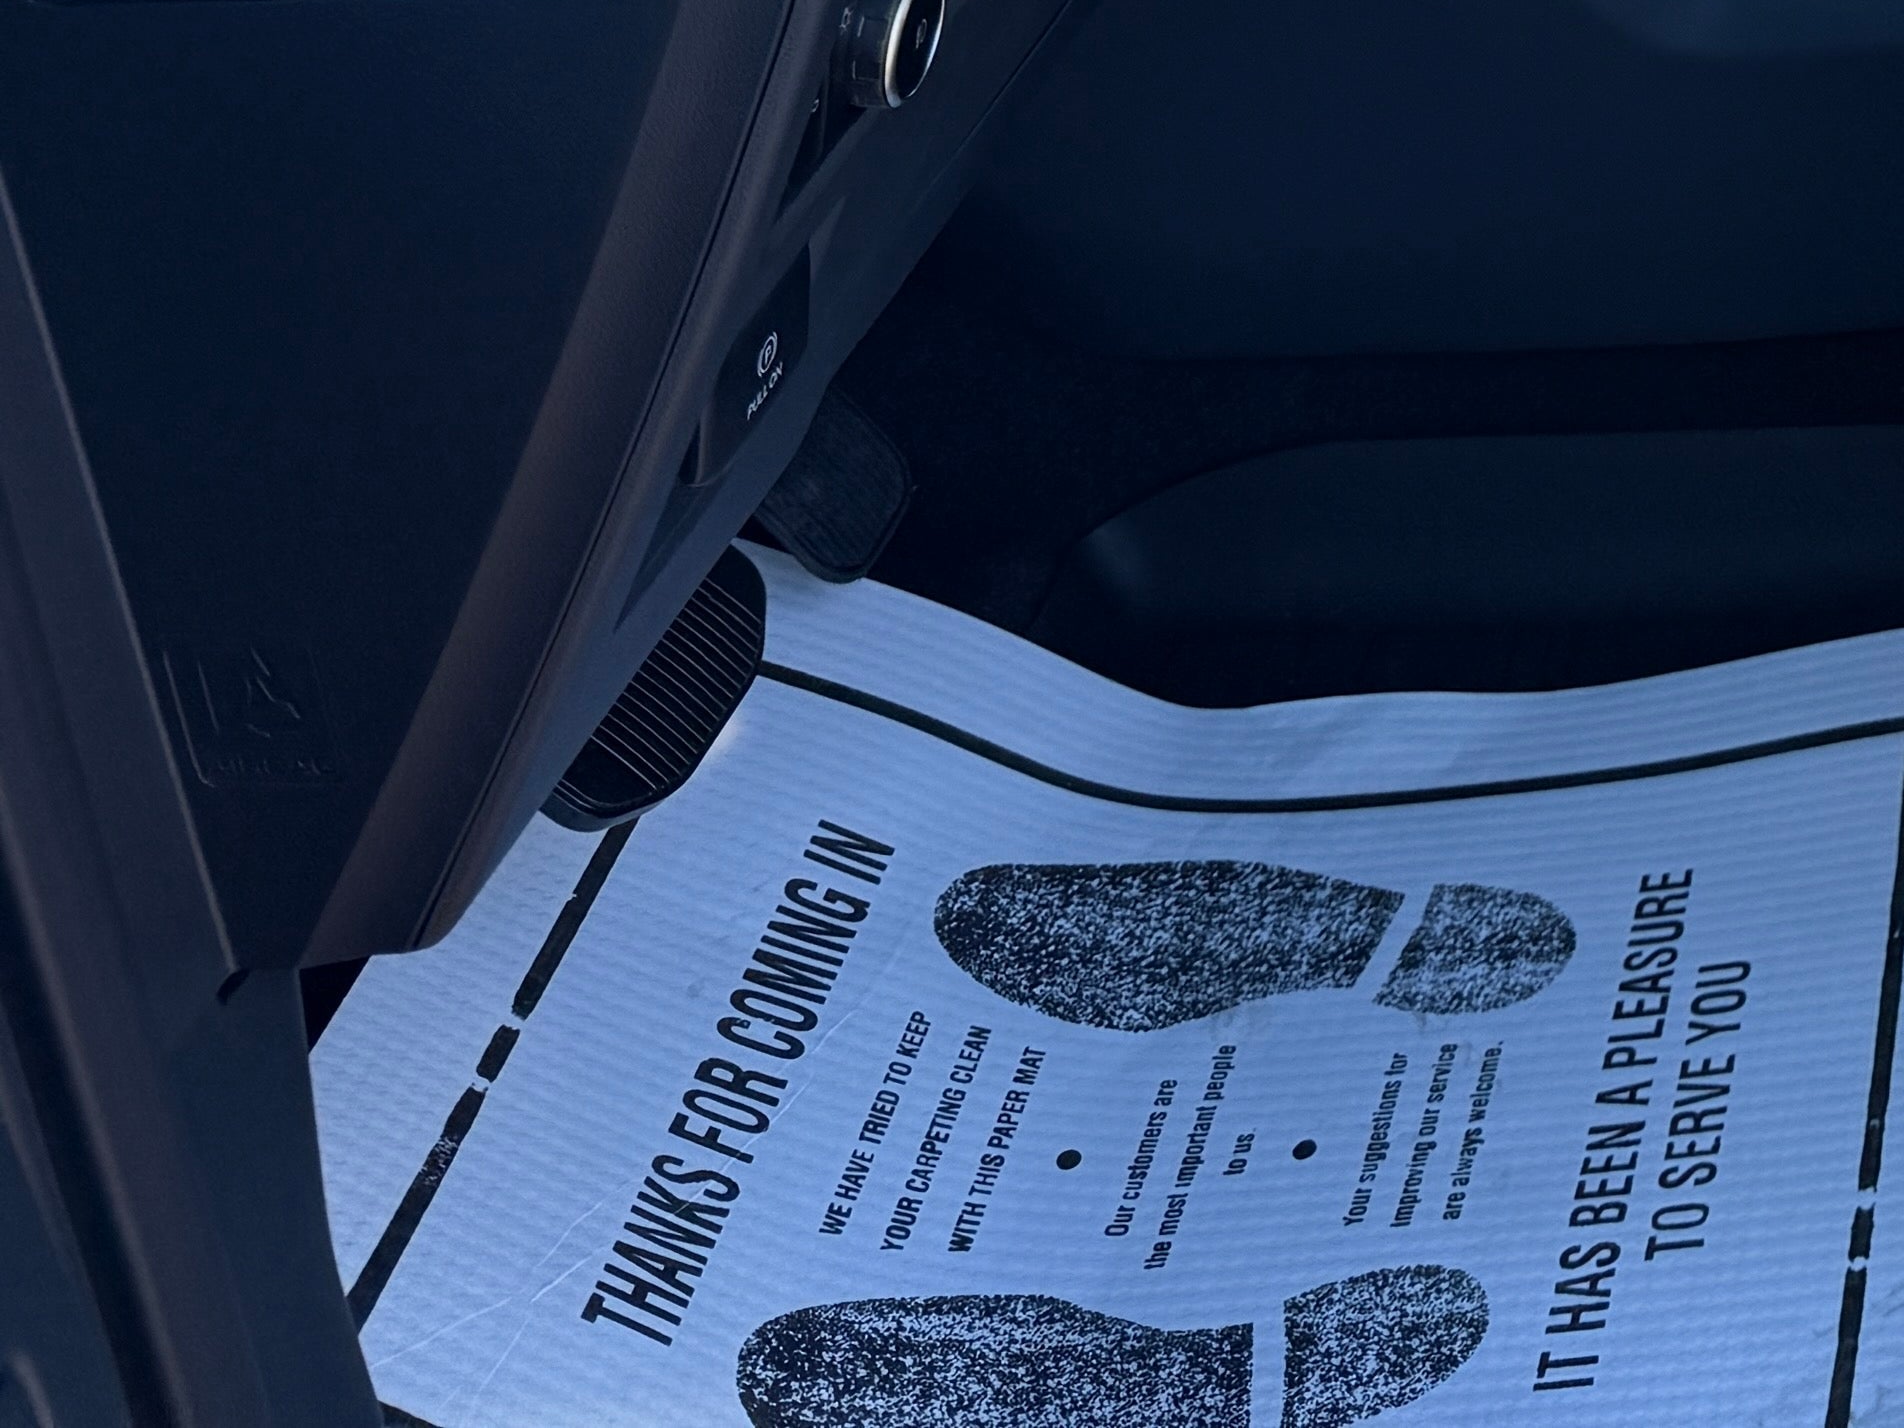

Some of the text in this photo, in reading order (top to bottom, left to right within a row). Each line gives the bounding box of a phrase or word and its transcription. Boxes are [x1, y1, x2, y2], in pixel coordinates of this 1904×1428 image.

[747, 362, 783, 420] PULL ON
[581, 819, 895, 1346] THANKS FOR COMING IN
[819, 1010, 931, 1235] WE HAVE TRIED TO KEEP
[880, 1025, 992, 1250] YOUR CARPETING CLEAN
[948, 1046, 1046, 1252] WITH THIS PAPER MAT
[1104, 1079, 1178, 1236] Our customers are
[1144, 1045, 1237, 1269] the most important people
[1223, 1158, 1247, 1176] to
[1342, 1052, 1408, 1226] Your suggestions for
[1419, 1108, 1440, 1137] our
[1427, 1043, 1458, 1104] service
[1442, 1040, 1504, 1220] are always welcome.
[1533, 868, 1693, 1392] IT HAS BEEN A PLEASURE
[1645, 960, 1752, 1261] TO SERVE YOU
